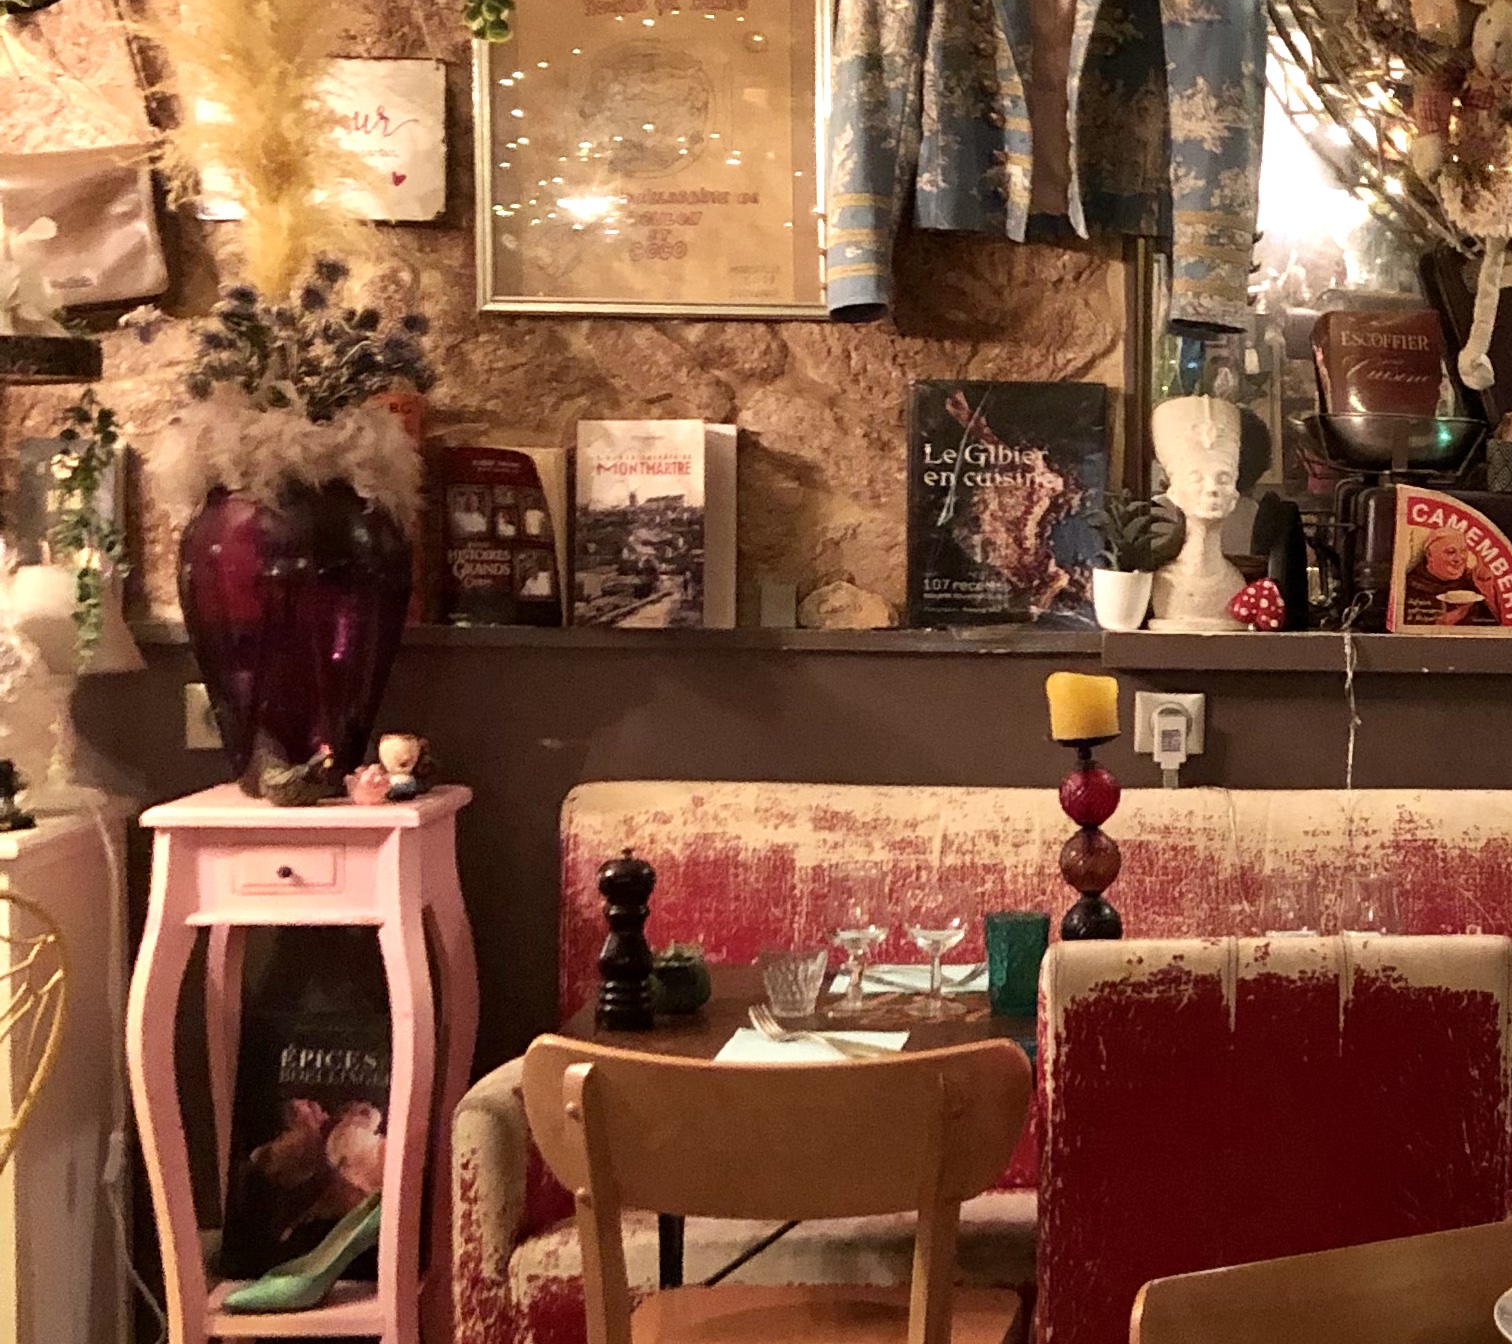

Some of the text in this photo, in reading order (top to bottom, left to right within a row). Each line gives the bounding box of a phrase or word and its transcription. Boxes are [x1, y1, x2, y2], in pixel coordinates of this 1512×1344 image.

[1341, 330, 1430, 351] ESCOFFIER
[924, 443, 957, 464] Le
[596, 461, 692, 475] MONTMARTRE
[923, 470, 955, 487] en
